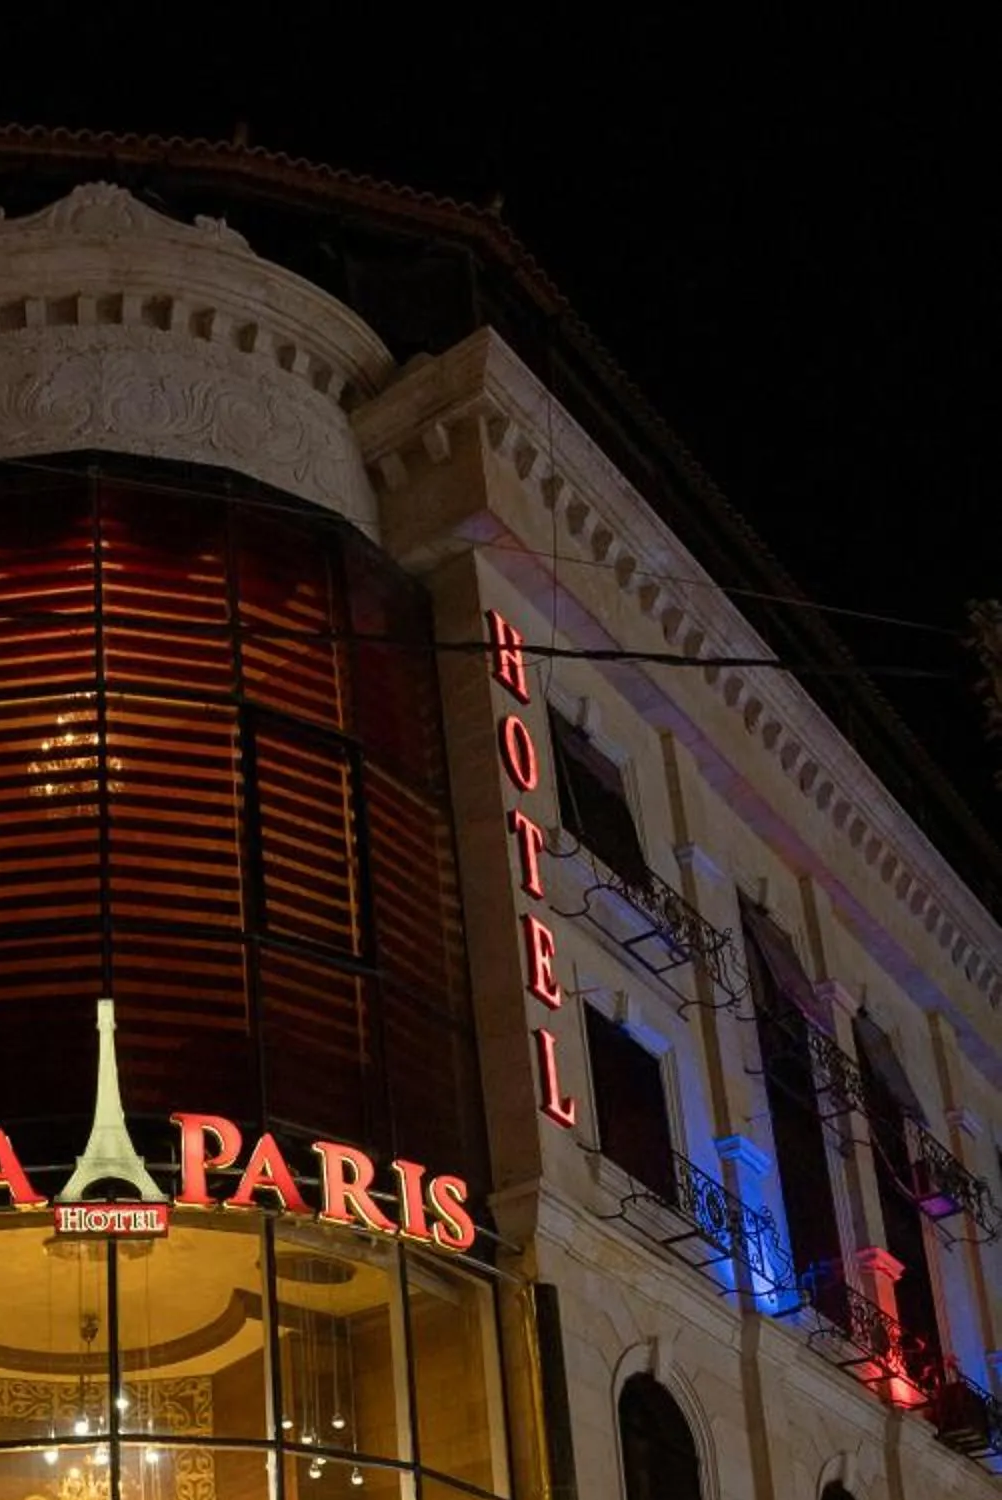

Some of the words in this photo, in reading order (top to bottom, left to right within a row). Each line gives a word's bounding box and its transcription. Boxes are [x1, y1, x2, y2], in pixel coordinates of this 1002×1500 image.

[487, 608, 576, 1130] HOTEL
[59, 1207, 166, 1233] HOTEL
[169, 1112, 477, 1253] PARIS
